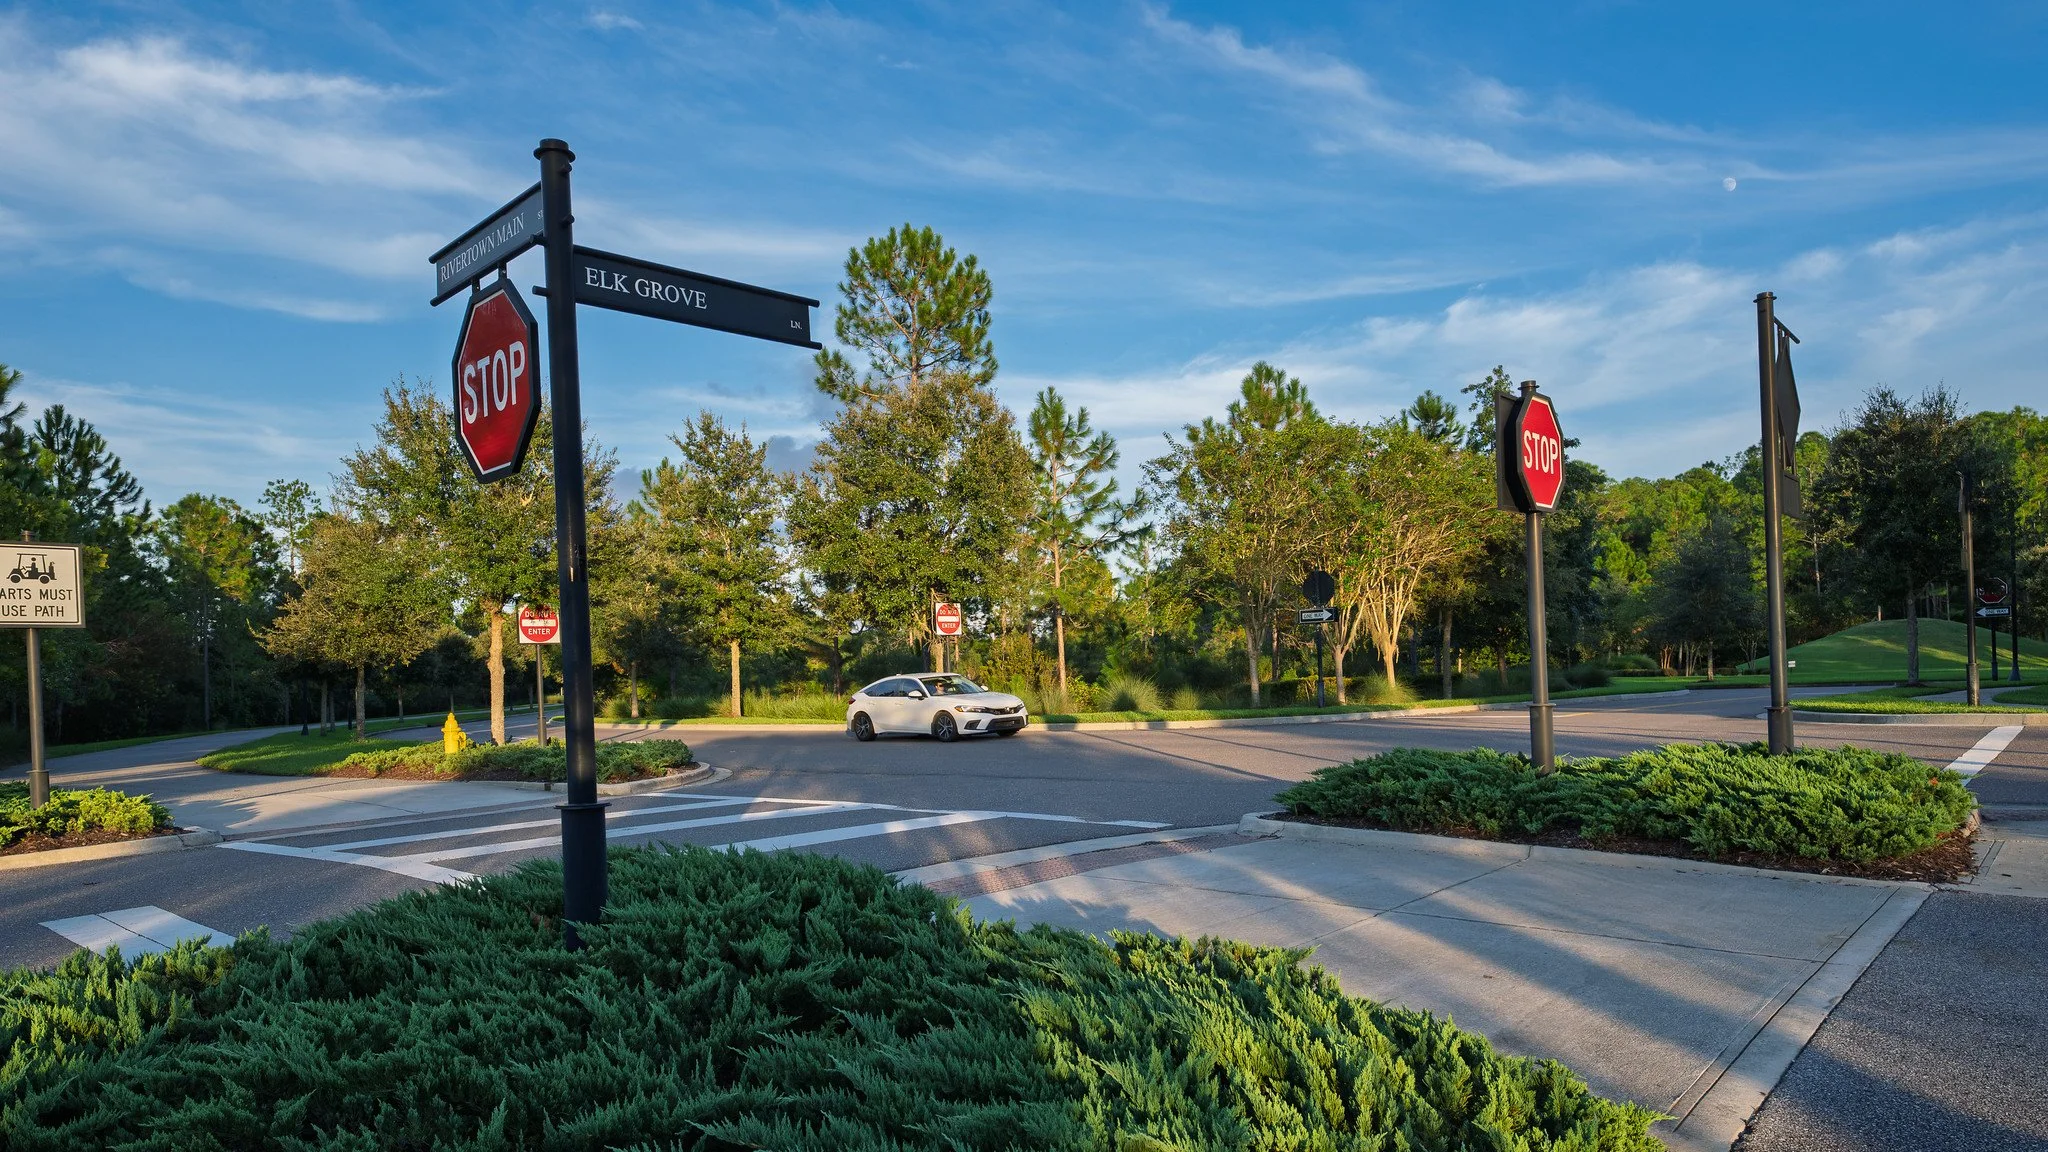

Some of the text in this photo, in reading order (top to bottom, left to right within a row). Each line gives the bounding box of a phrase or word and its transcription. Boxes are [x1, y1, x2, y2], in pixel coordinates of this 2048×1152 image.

[440, 232, 495, 282] RIVERTOWN
[497, 212, 524, 246] MAIN
[584, 266, 630, 294] ELK
[634, 278, 708, 309] GROVE
[463, 340, 526, 424] STOP
[1523, 429, 1559, 475] STOP
[1, 604, 65, 617] USE PATH
[39, 588, 73, 601] MUST
[524, 610, 535, 618] DO
